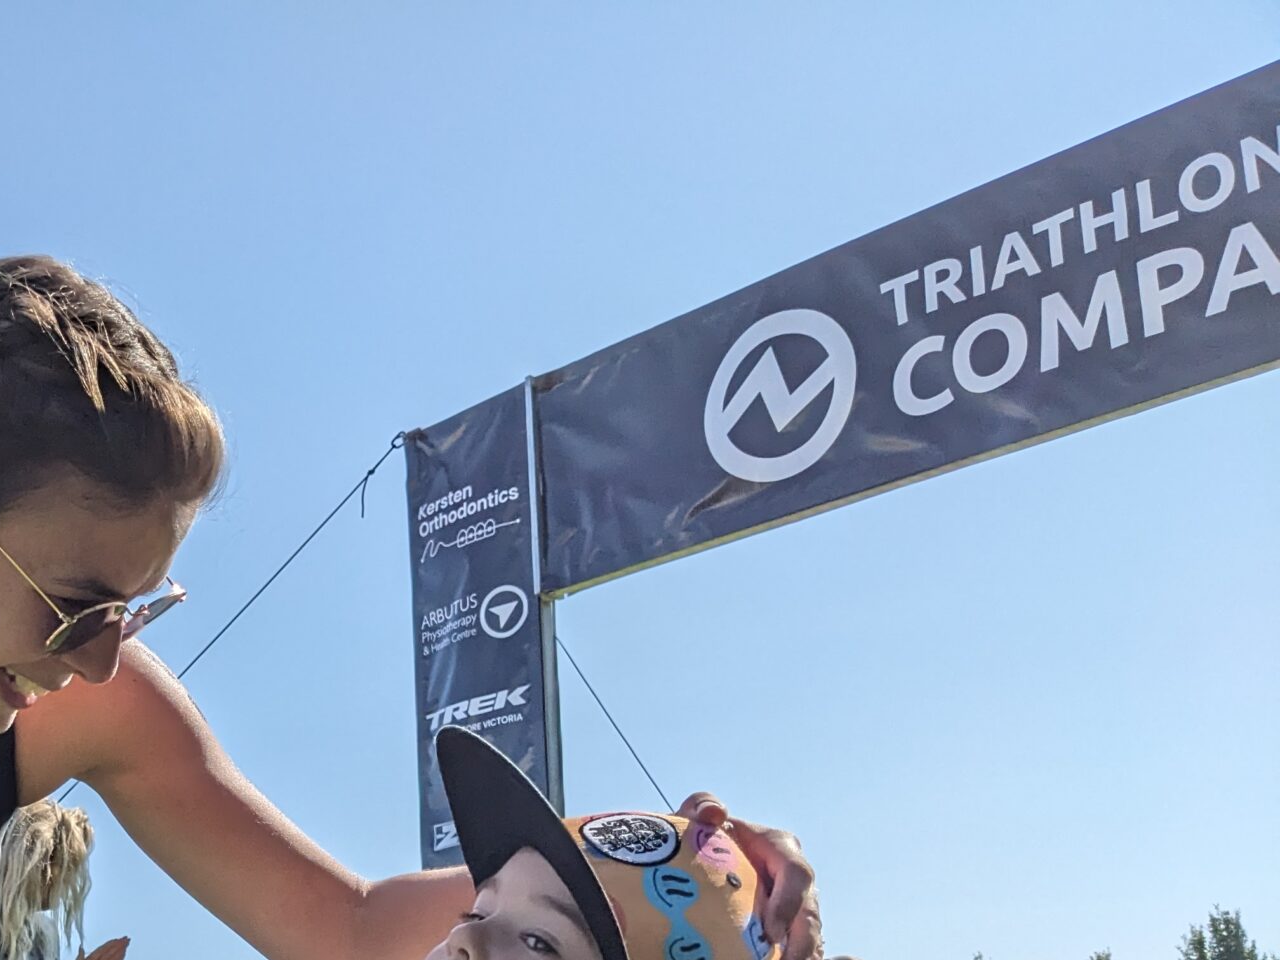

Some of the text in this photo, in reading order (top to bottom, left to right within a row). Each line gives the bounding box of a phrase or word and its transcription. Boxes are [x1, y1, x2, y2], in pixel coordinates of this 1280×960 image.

[880, 125, 1280, 326] TRIATHLON
[418, 485, 473, 520] Kersten
[419, 486, 520, 538] Orthodontics
[421, 593, 478, 630] ARBUTUS
[421, 614, 478, 643] Physiotherapy
[426, 684, 531, 731] TREK
[483, 713, 523, 729] VICTORIA
